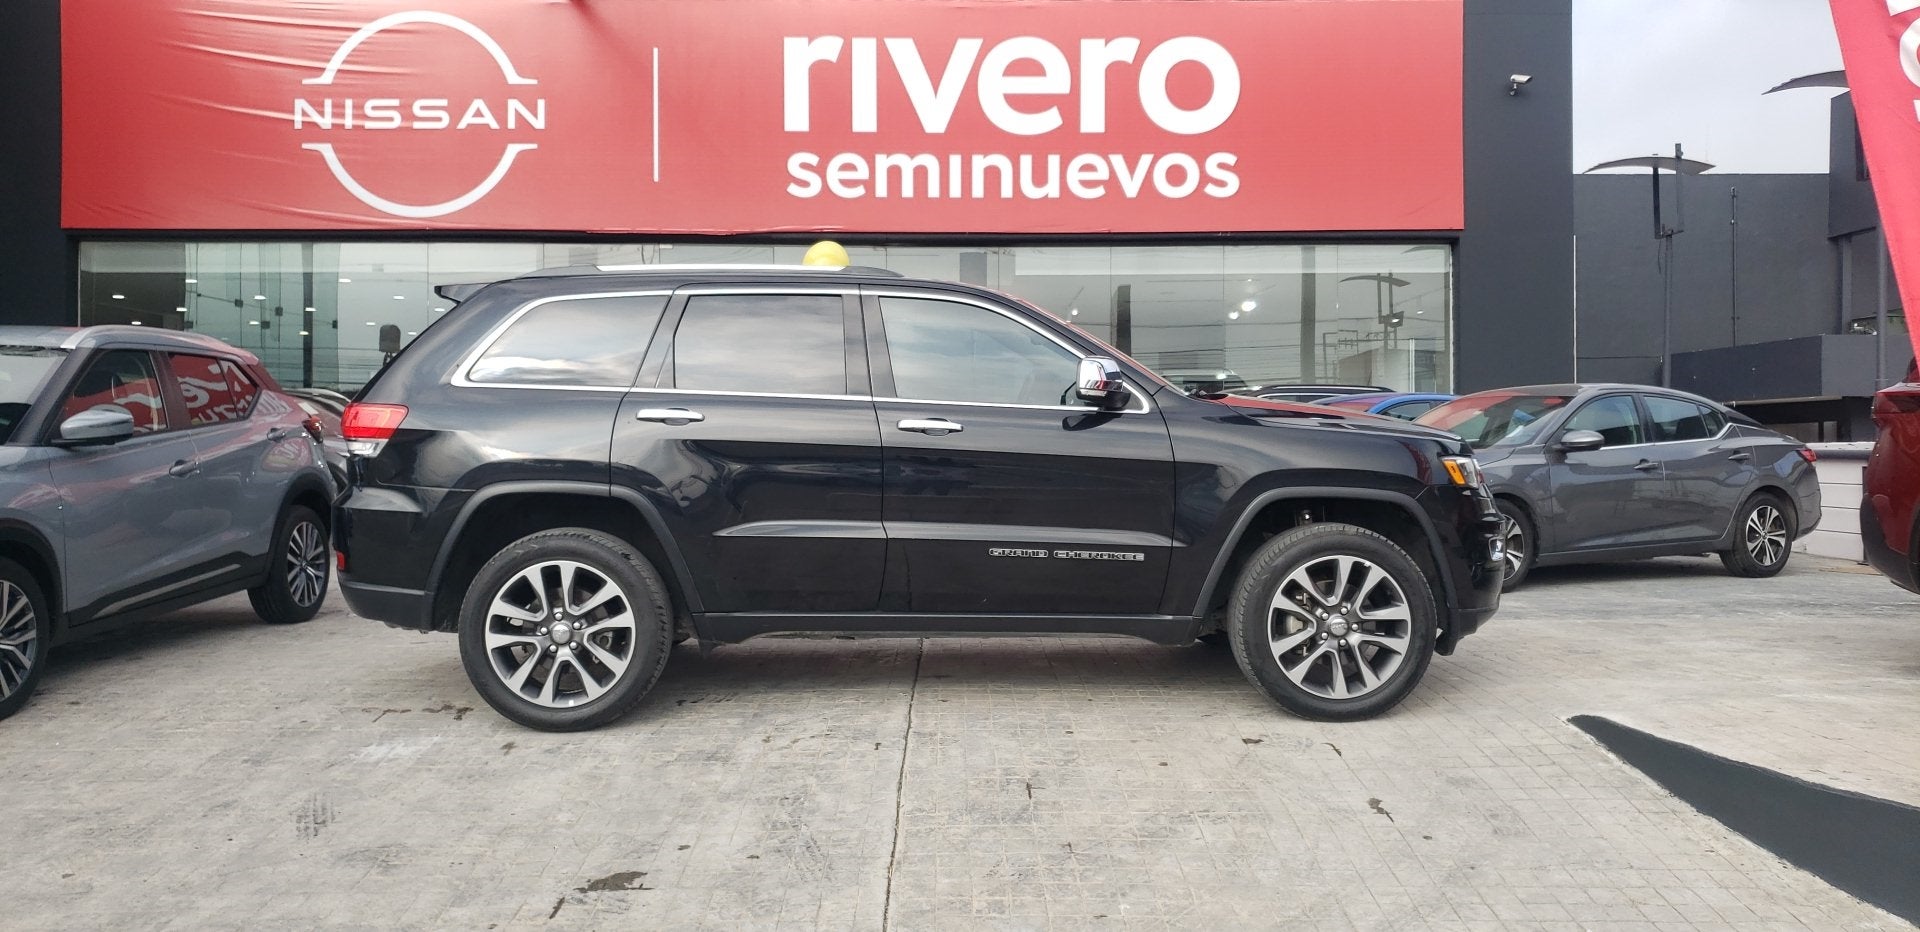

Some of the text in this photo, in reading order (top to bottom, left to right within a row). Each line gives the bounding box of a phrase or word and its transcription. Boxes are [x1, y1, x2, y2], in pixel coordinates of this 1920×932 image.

[783, 35, 1241, 136] rivero
[293, 98, 546, 130] NISSAN
[786, 152, 1241, 199] seminuevos
[989, 548, 1145, 562] GRAND CHEROKEE
